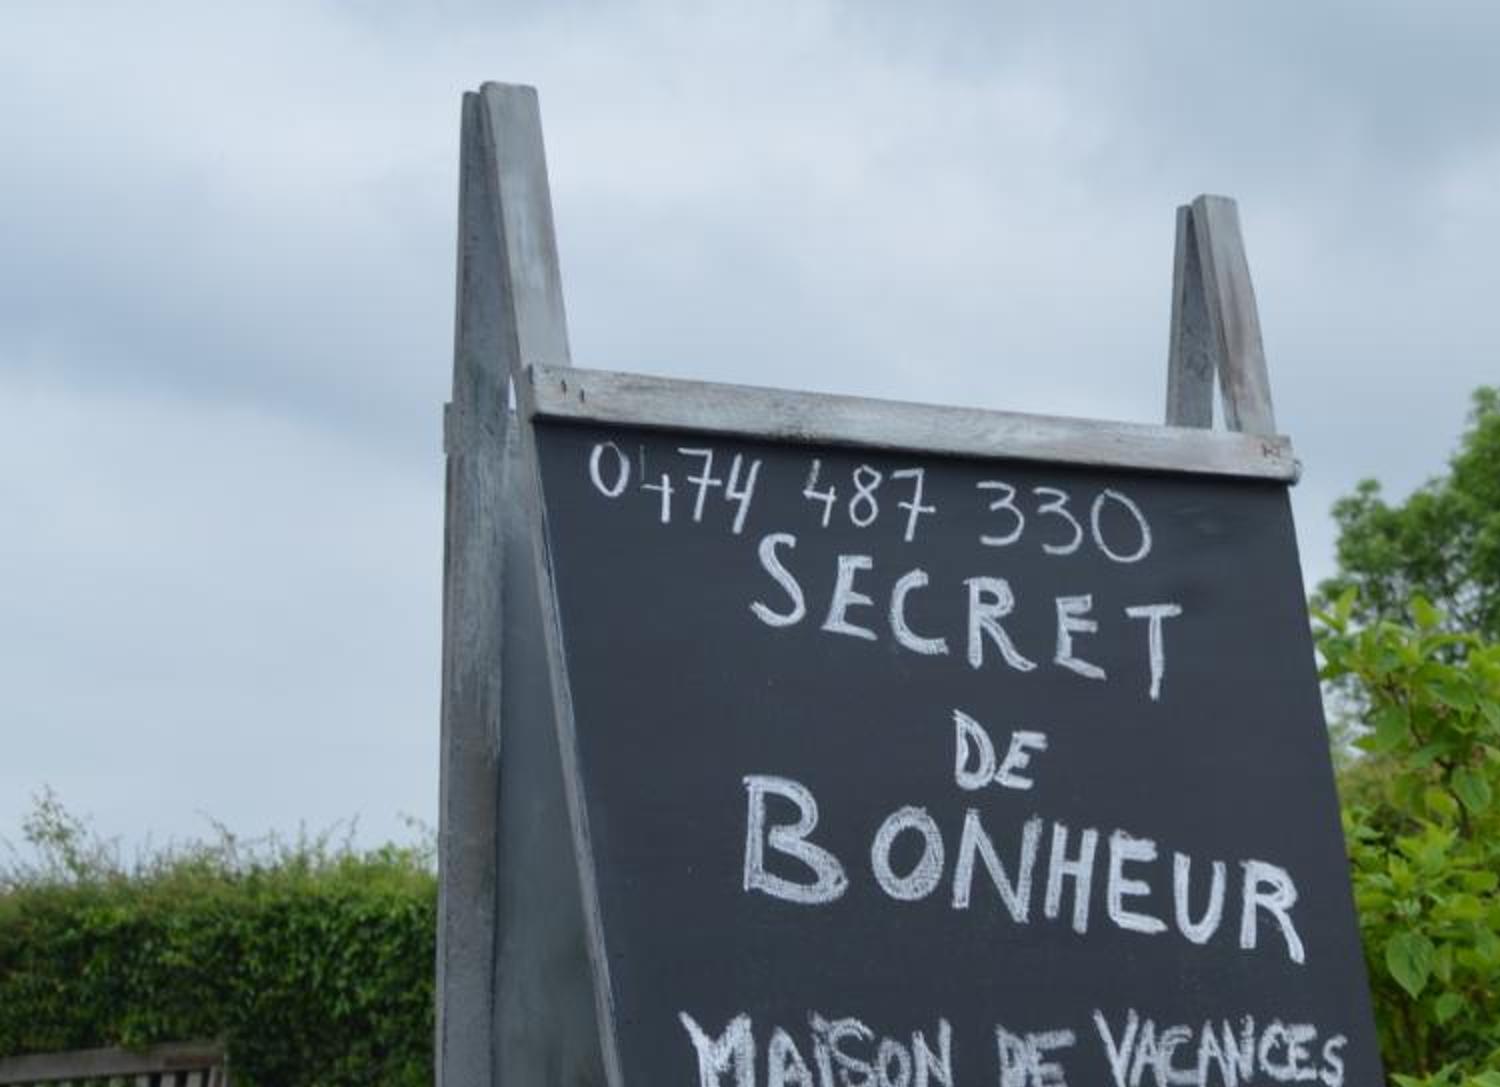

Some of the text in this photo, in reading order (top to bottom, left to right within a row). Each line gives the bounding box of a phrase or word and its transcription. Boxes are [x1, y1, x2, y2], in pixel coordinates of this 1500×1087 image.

[588, 443, 1153, 564] 0474 487 330
[748, 531, 1184, 702] SECRET
[951, 707, 1049, 792] DE
[741, 773, 1307, 966] BONHEUR
